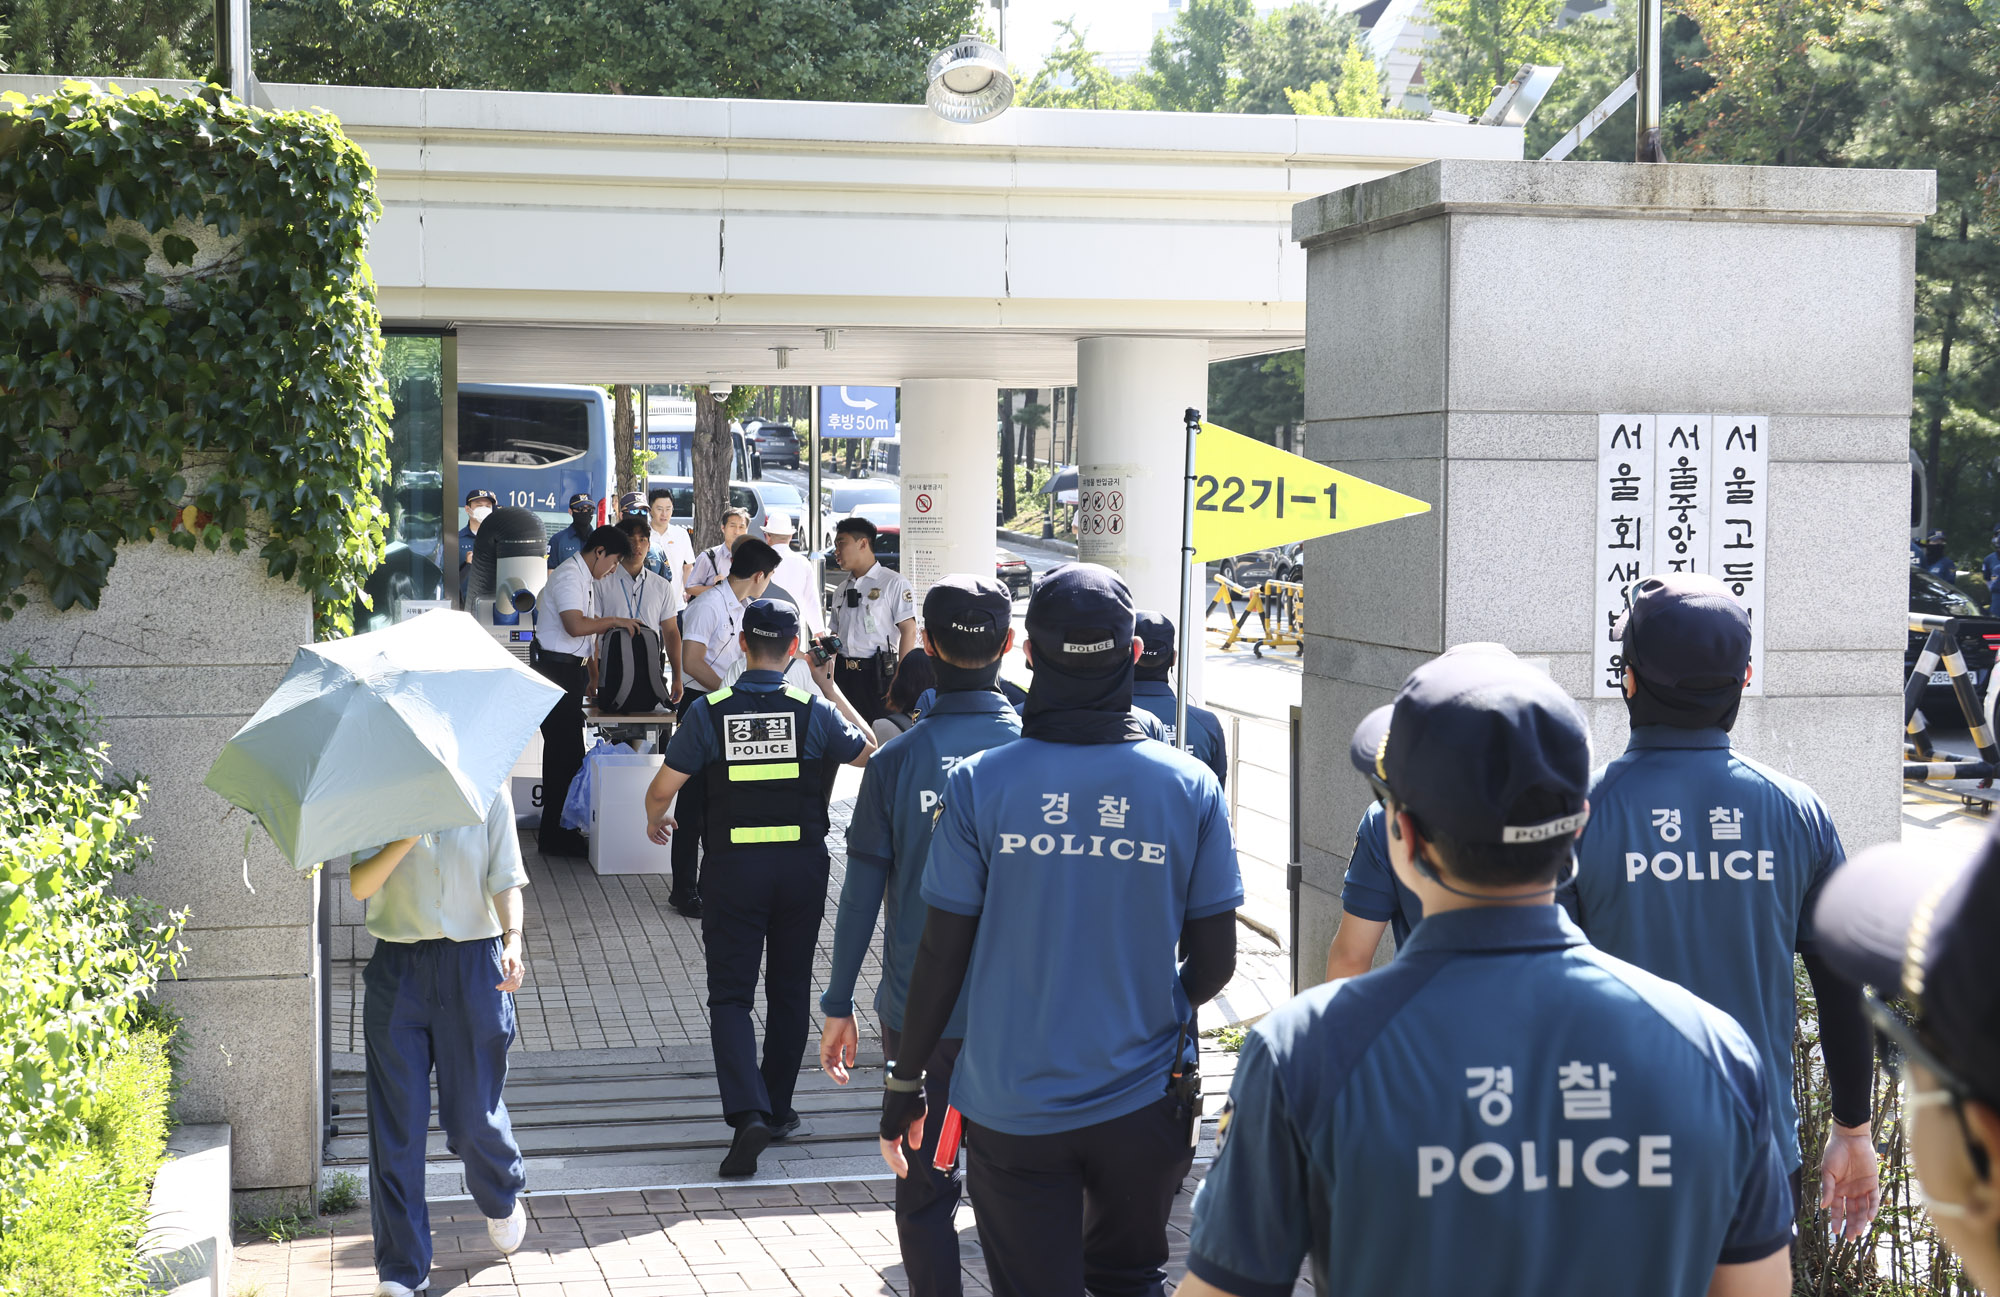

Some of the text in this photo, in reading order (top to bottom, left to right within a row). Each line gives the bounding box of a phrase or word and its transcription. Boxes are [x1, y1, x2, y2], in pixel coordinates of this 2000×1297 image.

[1096, 477, 1120, 487] 반입금지
[509, 490, 556, 509] 101-4
[1195, 474, 1337, 519] 22기-1
[951, 621, 985, 633] POLICE
[1069, 640, 1112, 653] POLICE
[733, 744, 789, 756] POLICE
[1515, 814, 1584, 841] POLICE
[998, 832, 1167, 865] POLICE
[1625, 849, 1775, 882] POLICE
[1417, 1134, 1673, 1198] POLICE
